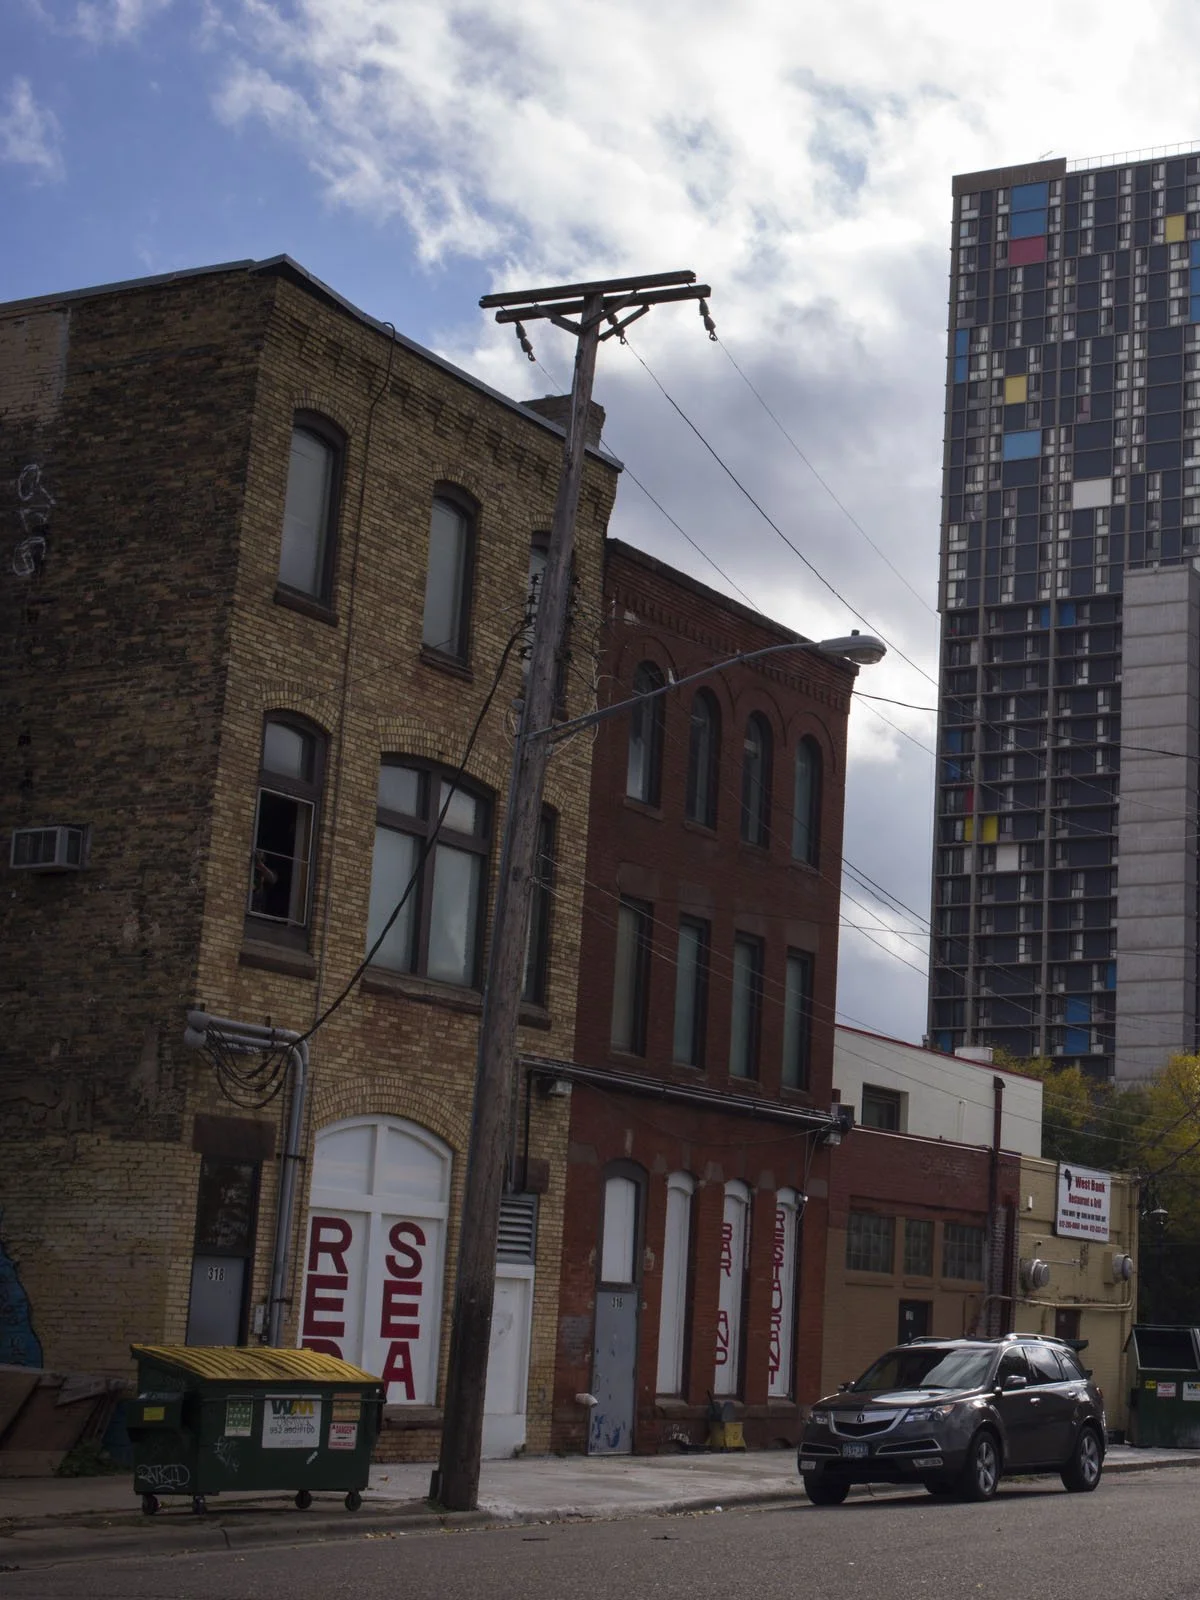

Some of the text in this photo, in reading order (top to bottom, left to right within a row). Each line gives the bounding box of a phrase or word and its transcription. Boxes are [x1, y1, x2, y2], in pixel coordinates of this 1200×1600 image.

[1076, 1176, 1105, 1193] West Bank
[208, 1267, 224, 1281] 318
[302, 1216, 352, 1360] RE
[380, 1221, 426, 1400] SEA
[715, 1222, 732, 1366] BAR AND
[271, 1400, 314, 1416] WM
